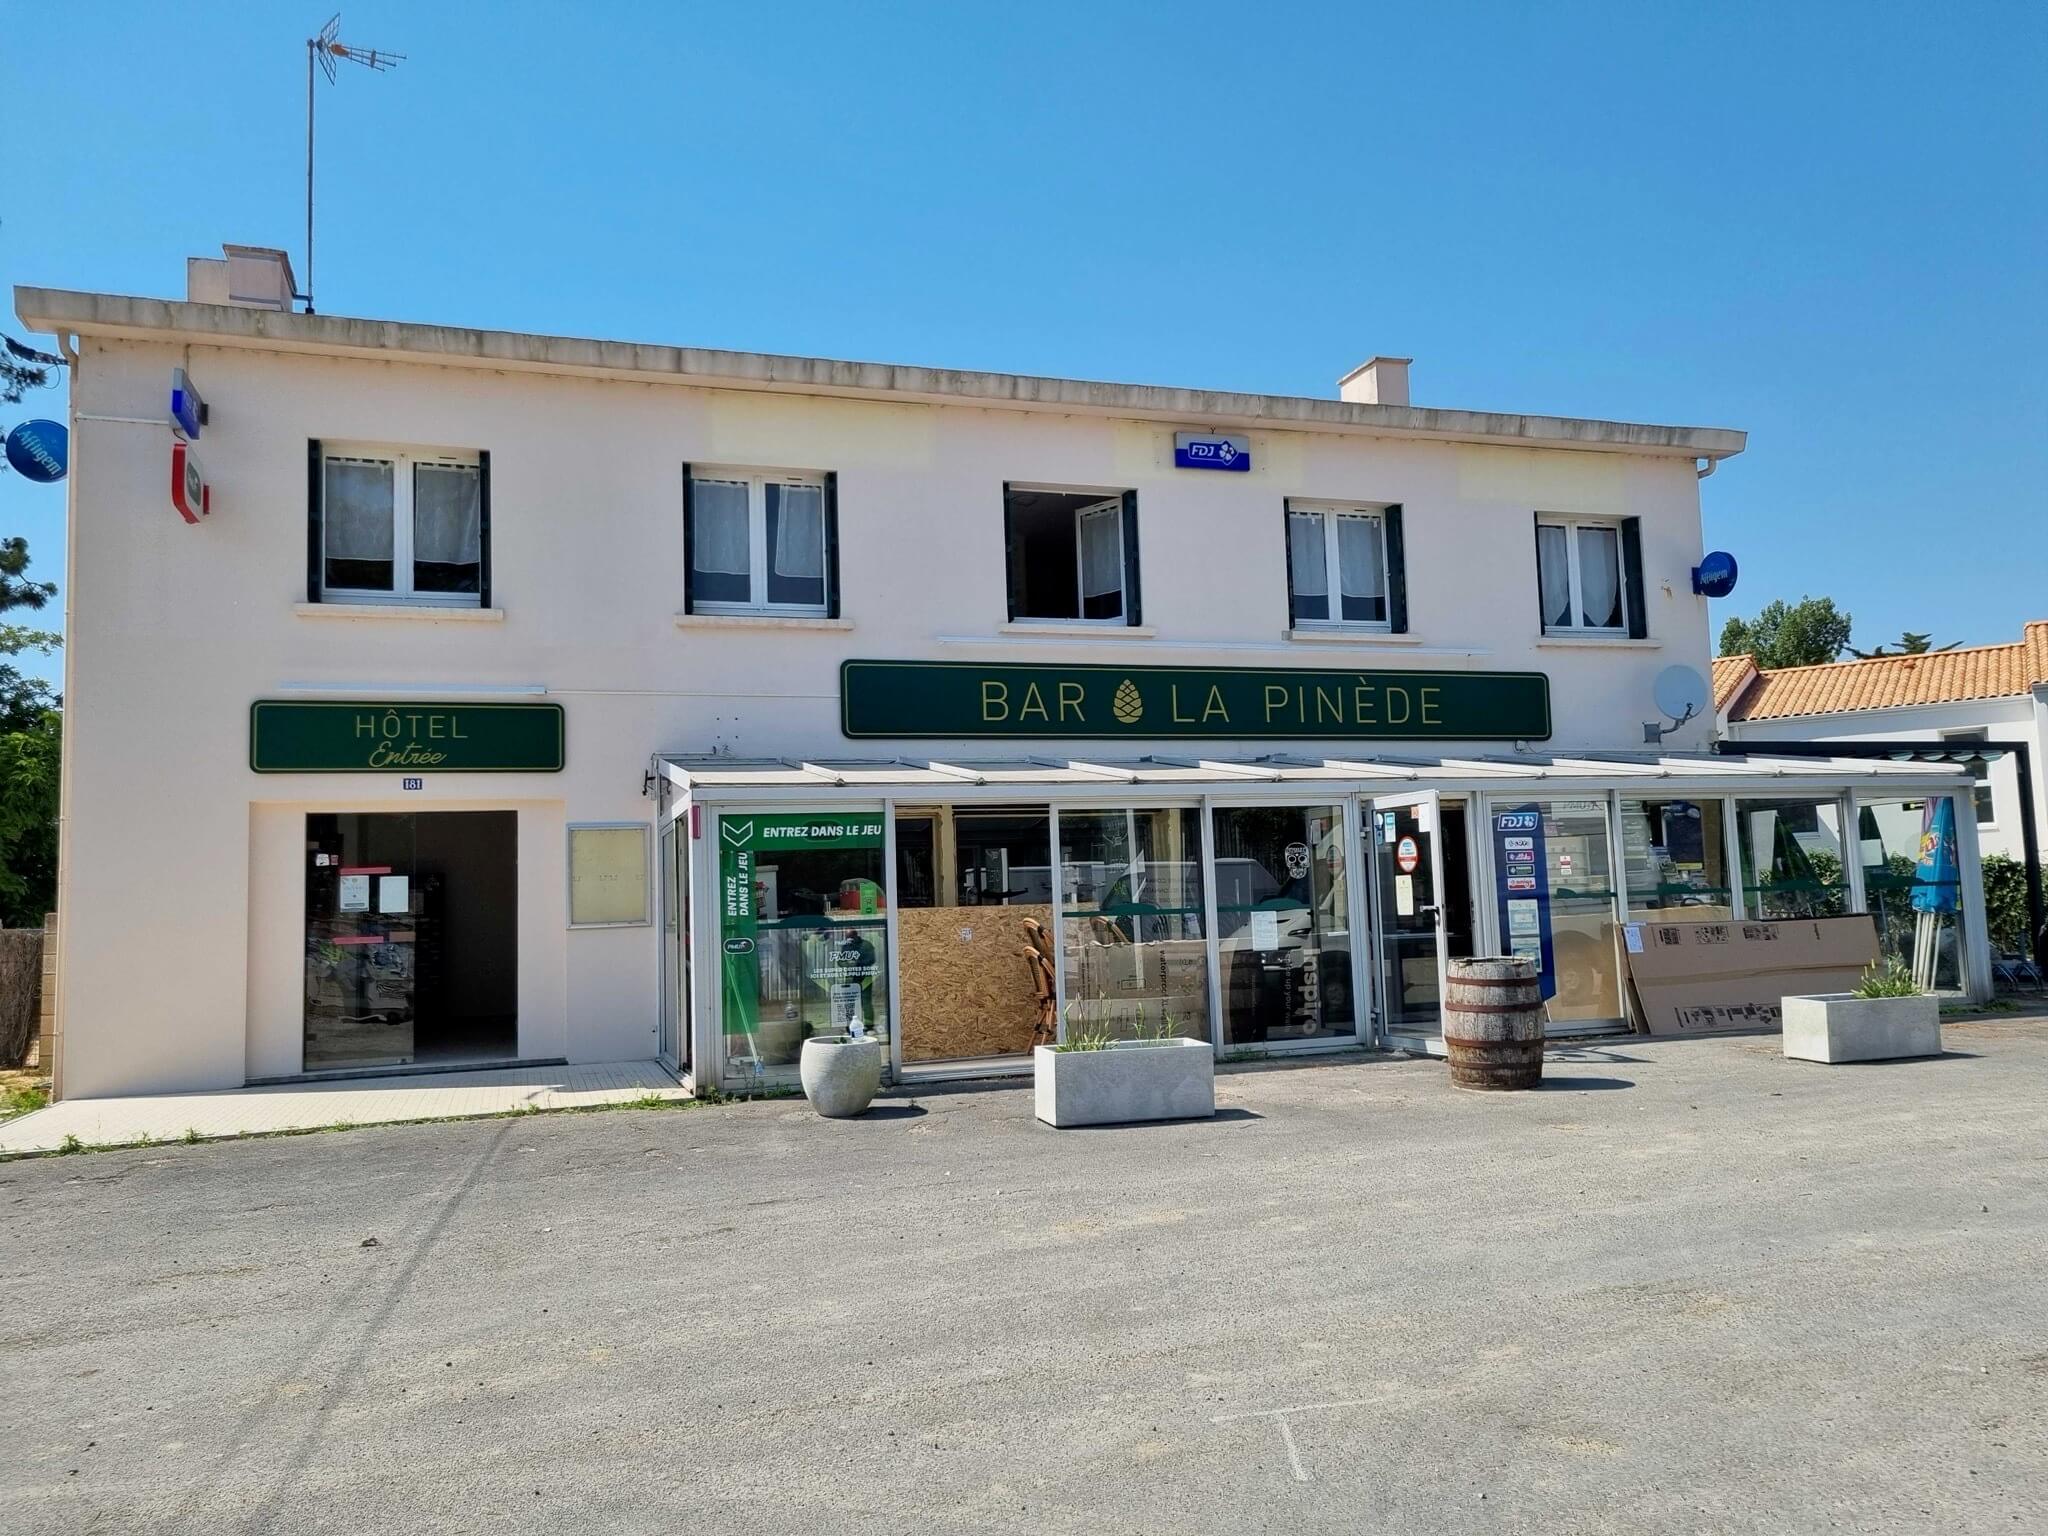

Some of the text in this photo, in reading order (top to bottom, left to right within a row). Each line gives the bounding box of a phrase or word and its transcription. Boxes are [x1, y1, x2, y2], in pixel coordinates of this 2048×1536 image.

[1191, 445, 1214, 457] FDJ
[981, 676, 1443, 724] BAR LA PINÈDE
[356, 708, 469, 738] HÔTEL
[368, 740, 448, 768] Entrée
[404, 779, 421, 790] 181
[763, 825, 882, 838] ENTREZ DANS LE JEU
[1500, 816, 1523, 828] FDJ
[727, 876, 737, 916] ENTREZ
[738, 852, 749, 916] DANS LE JEU
[1298, 948, 1321, 1035] Inspiro
